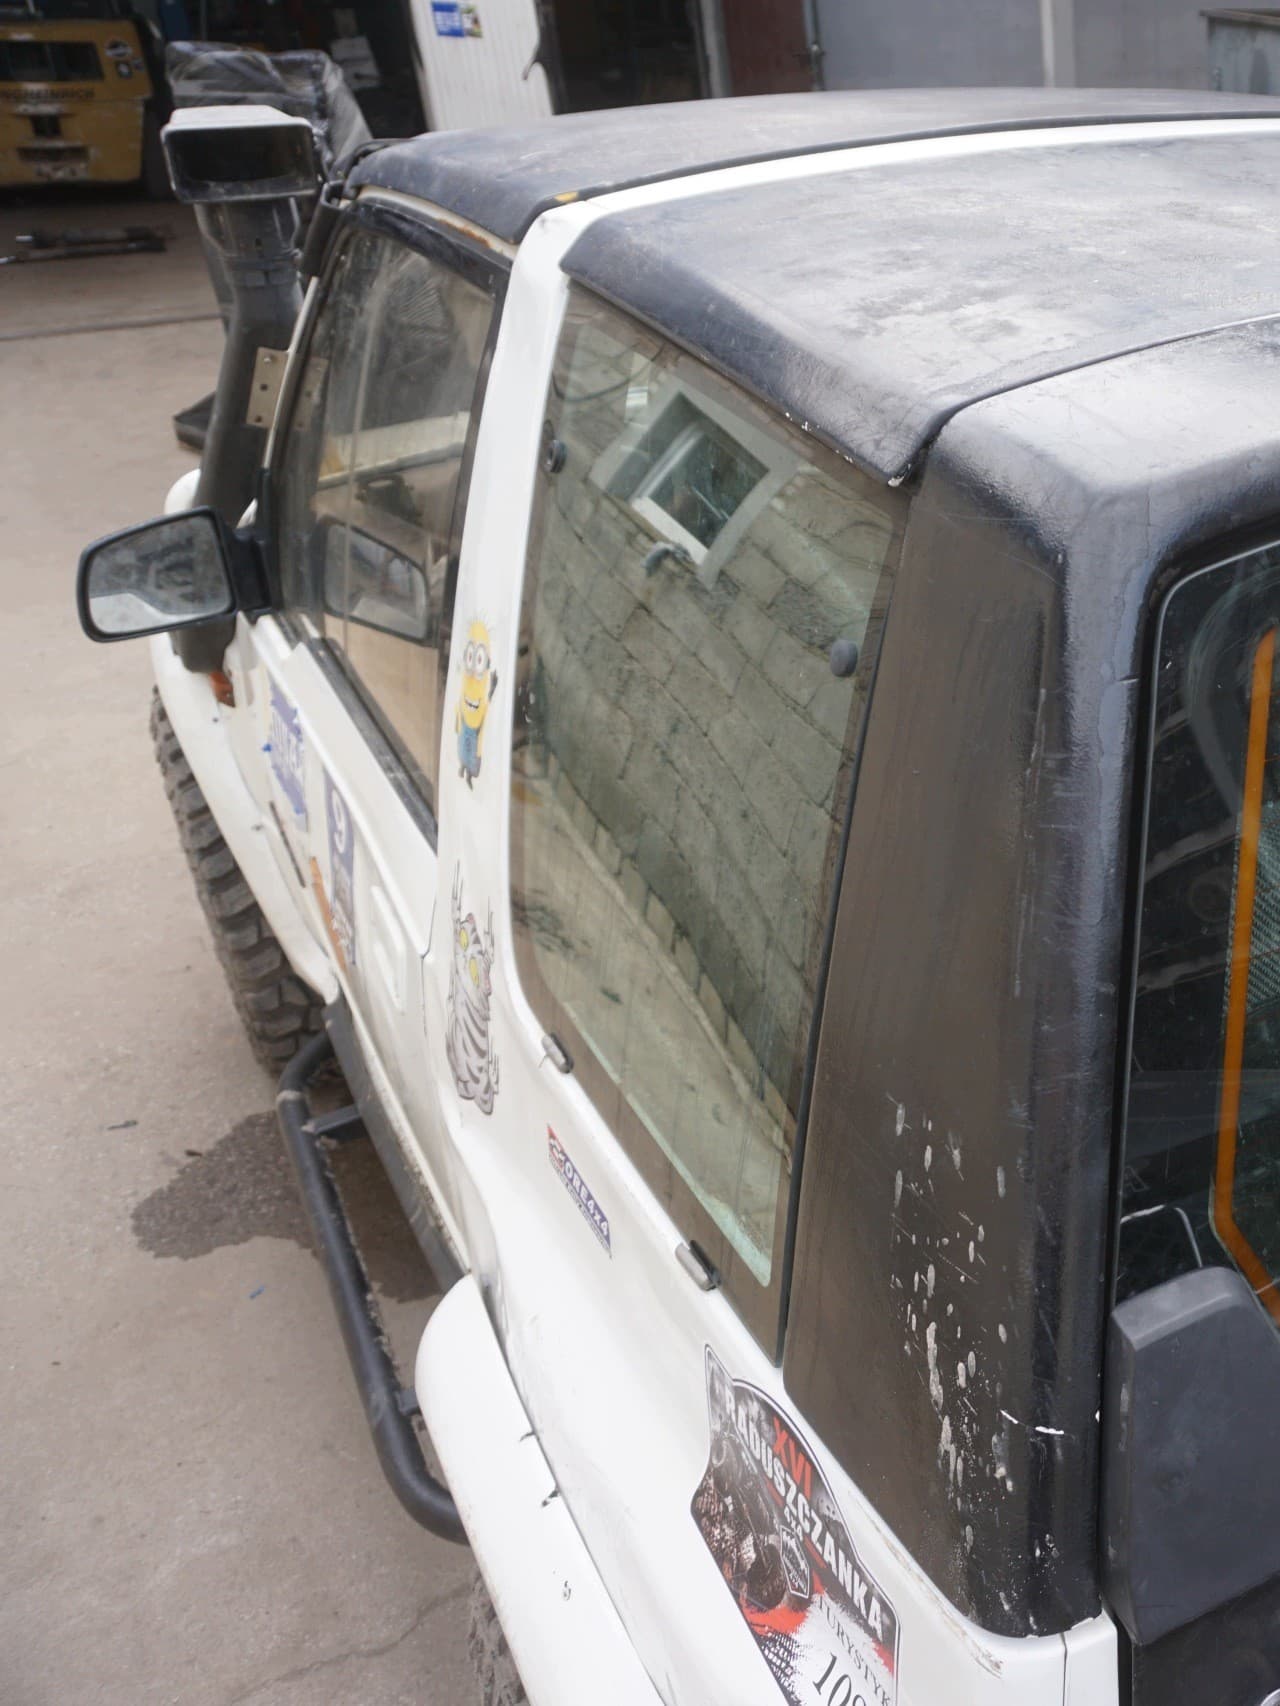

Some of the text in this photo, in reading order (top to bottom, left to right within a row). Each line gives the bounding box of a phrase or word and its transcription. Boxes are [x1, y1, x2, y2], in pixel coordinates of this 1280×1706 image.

[773, 1416, 812, 1501] XVI
[725, 1384, 883, 1643] RADUSZCZANKA
[784, 1505, 803, 1541] 4x4
